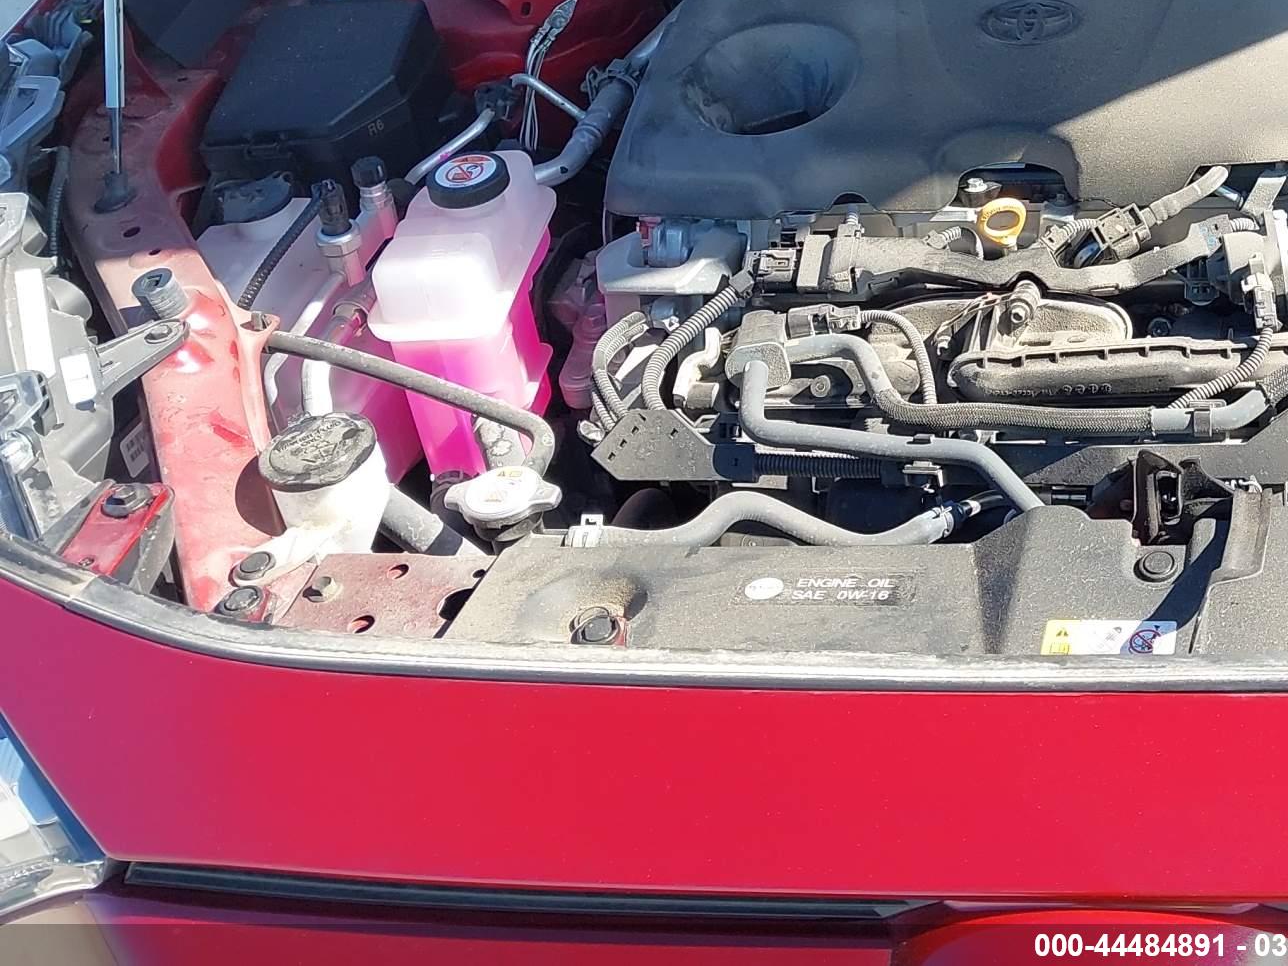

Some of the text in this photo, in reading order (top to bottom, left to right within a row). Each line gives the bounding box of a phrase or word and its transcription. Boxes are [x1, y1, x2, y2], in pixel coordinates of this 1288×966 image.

[797, 578, 896, 588] ENGINE OIL
[791, 590, 826, 600] SAE
